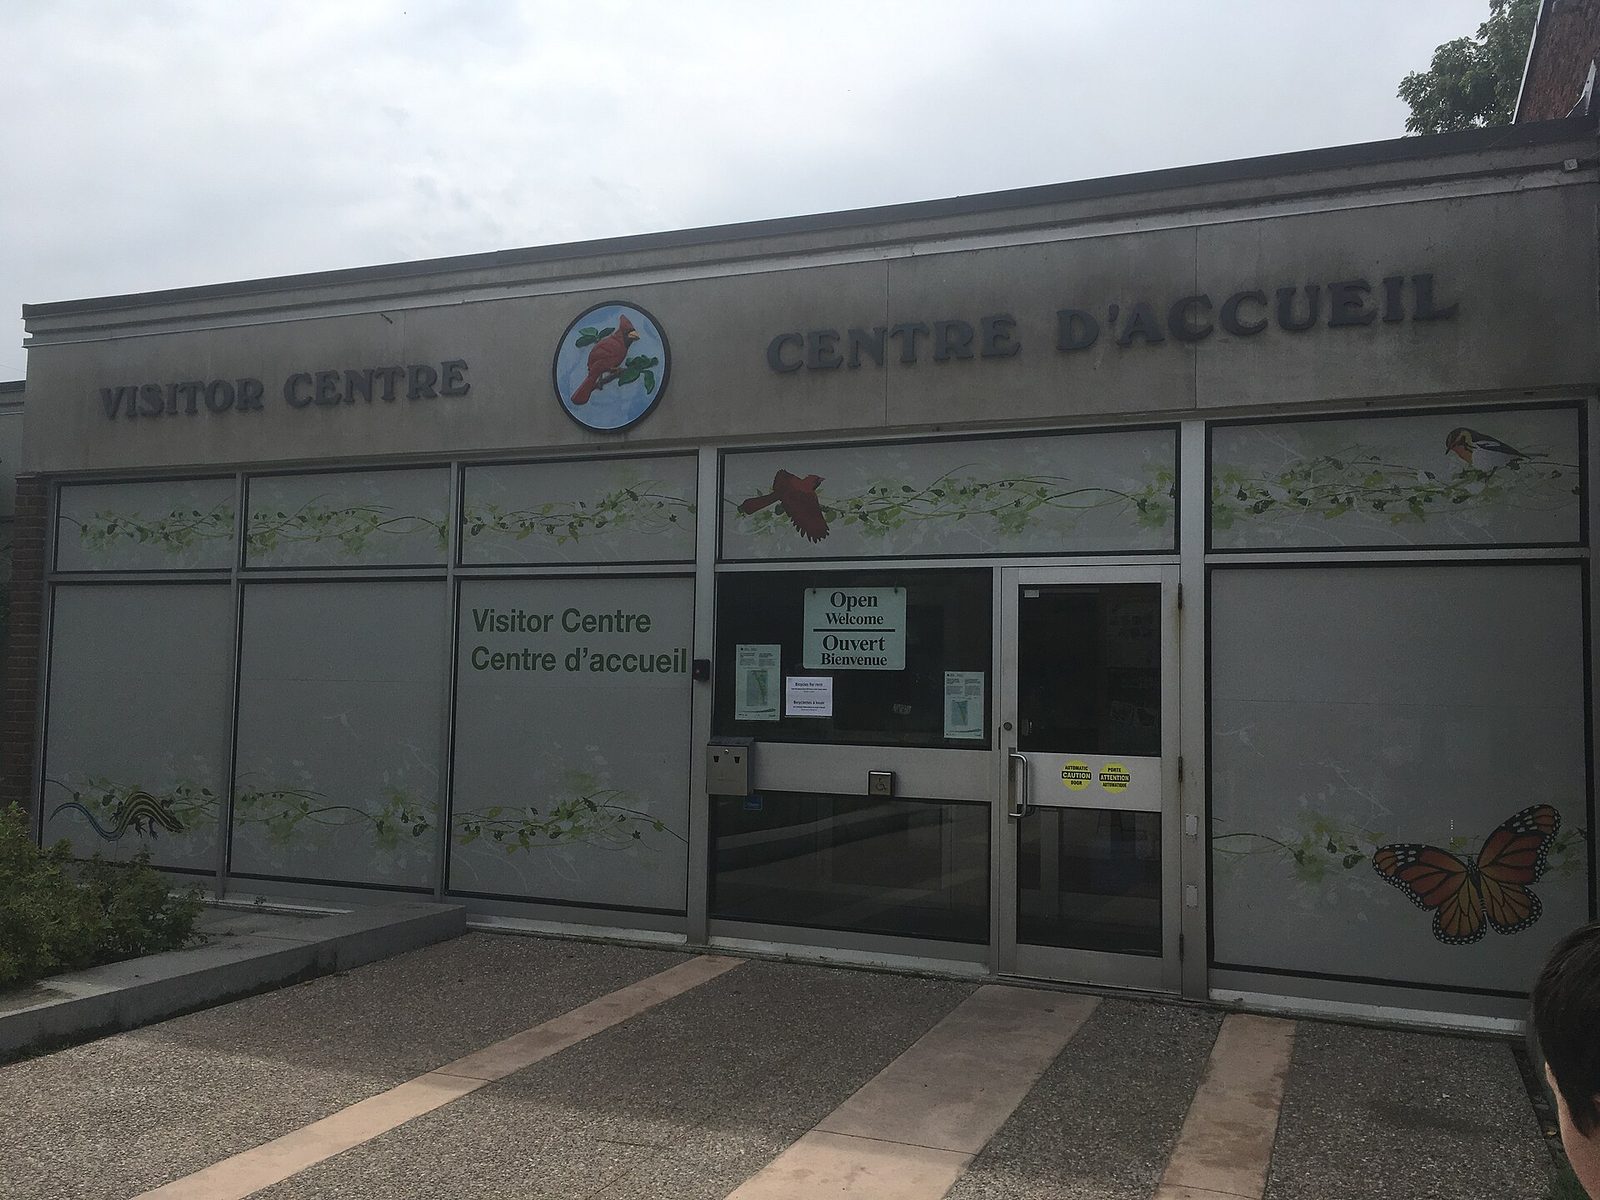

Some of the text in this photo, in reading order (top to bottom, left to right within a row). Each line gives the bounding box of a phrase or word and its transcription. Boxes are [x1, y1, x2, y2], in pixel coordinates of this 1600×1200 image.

[766, 273, 1460, 373] CENTRE D'ACCUEIL
[100, 358, 471, 421] VISITOR CENTRE
[830, 591, 878, 612] Open
[472, 607, 651, 633] Visitor Centre
[825, 612, 884, 625] Welcome
[822, 634, 886, 651] Ouvert
[471, 645, 556, 671] Centre
[821, 652, 888, 666] Bienvenue
